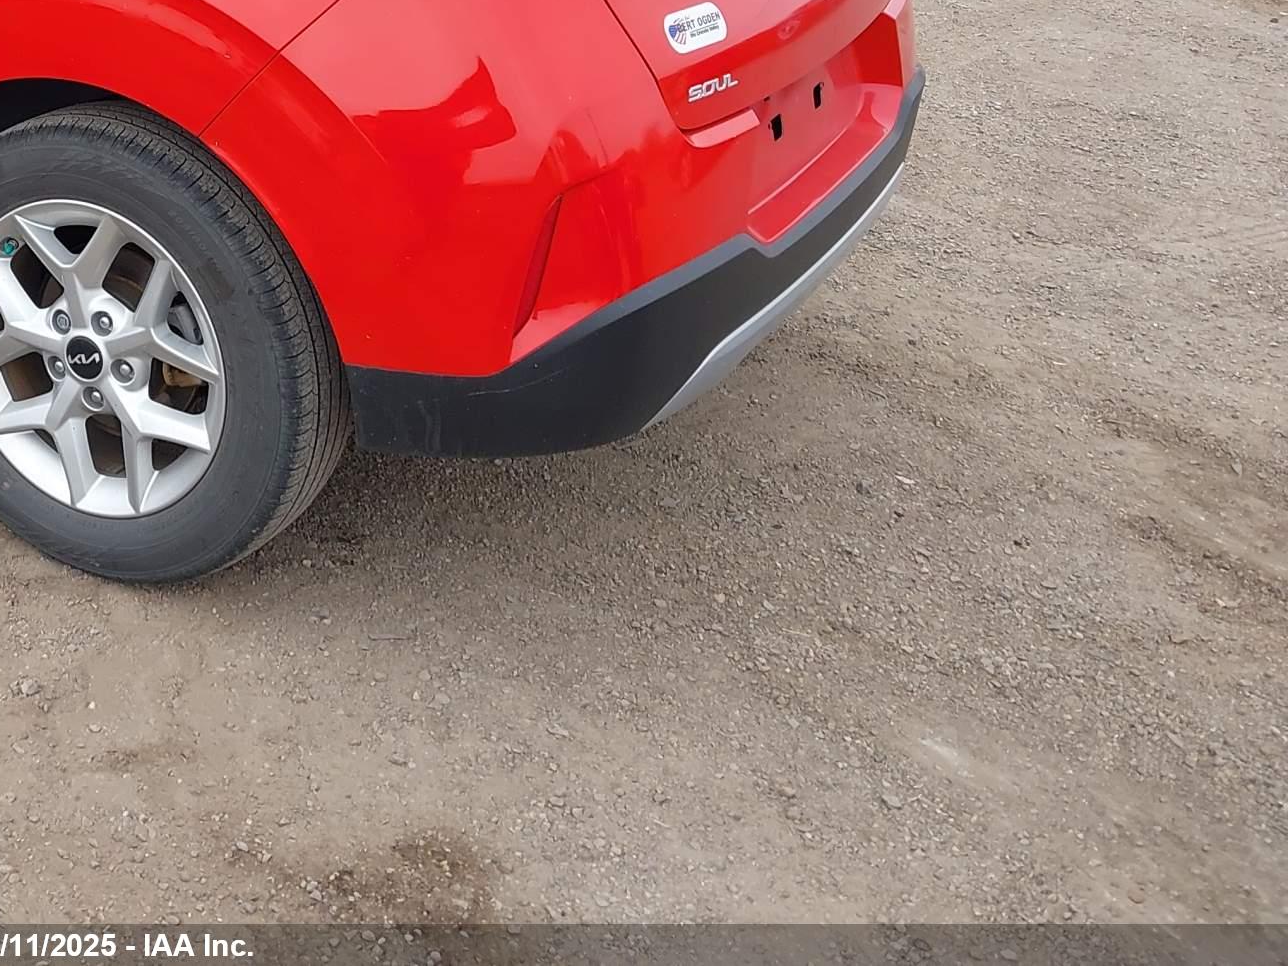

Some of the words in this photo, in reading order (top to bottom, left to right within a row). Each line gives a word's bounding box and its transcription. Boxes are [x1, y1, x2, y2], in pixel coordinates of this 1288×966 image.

[697, 12, 721, 26] OGDEN
[688, 74, 739, 103] SOUL
[68, 352, 100, 364] KIA
